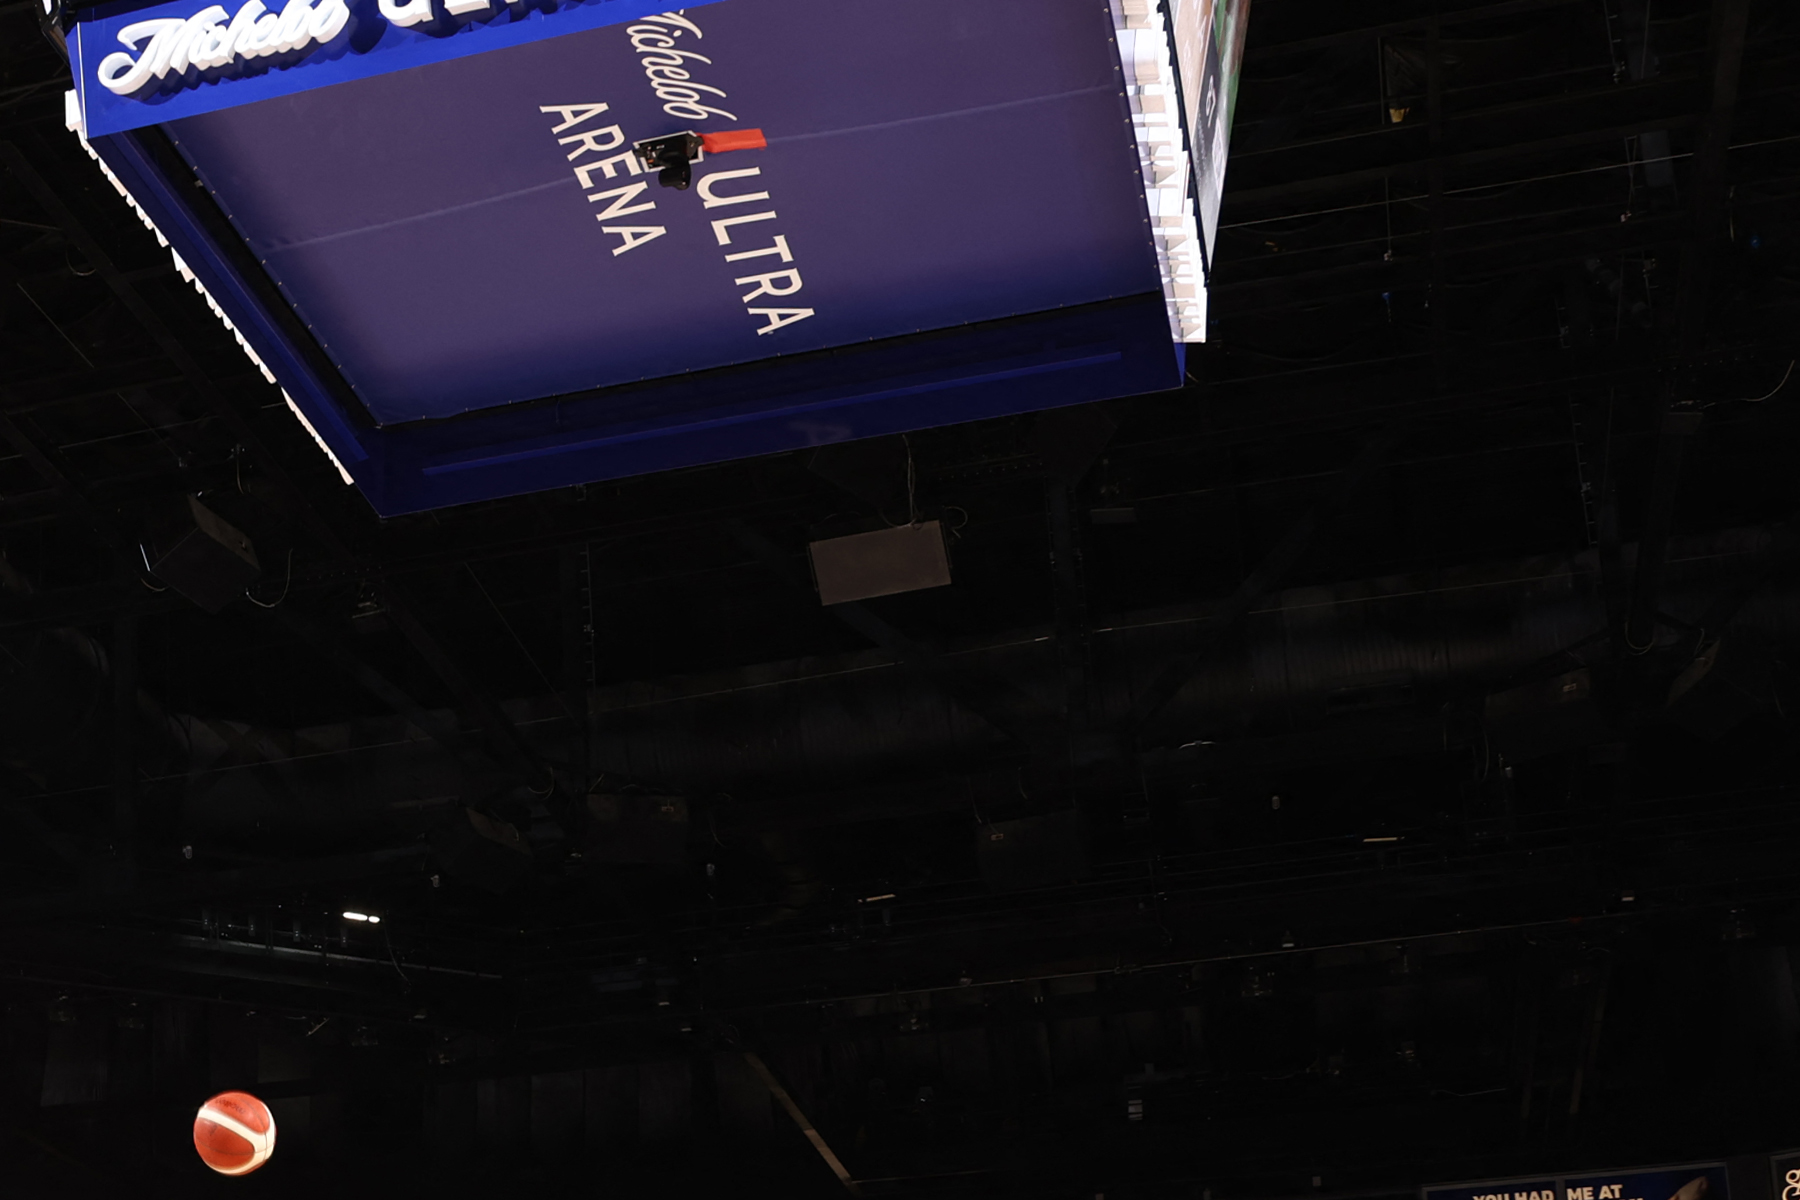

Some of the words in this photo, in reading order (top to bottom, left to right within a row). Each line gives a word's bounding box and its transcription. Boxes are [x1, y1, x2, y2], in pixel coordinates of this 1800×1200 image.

[539, 102, 667, 257] ARENA
[696, 166, 815, 336] ULTRA
[1599, 1184, 1623, 1199] AT
